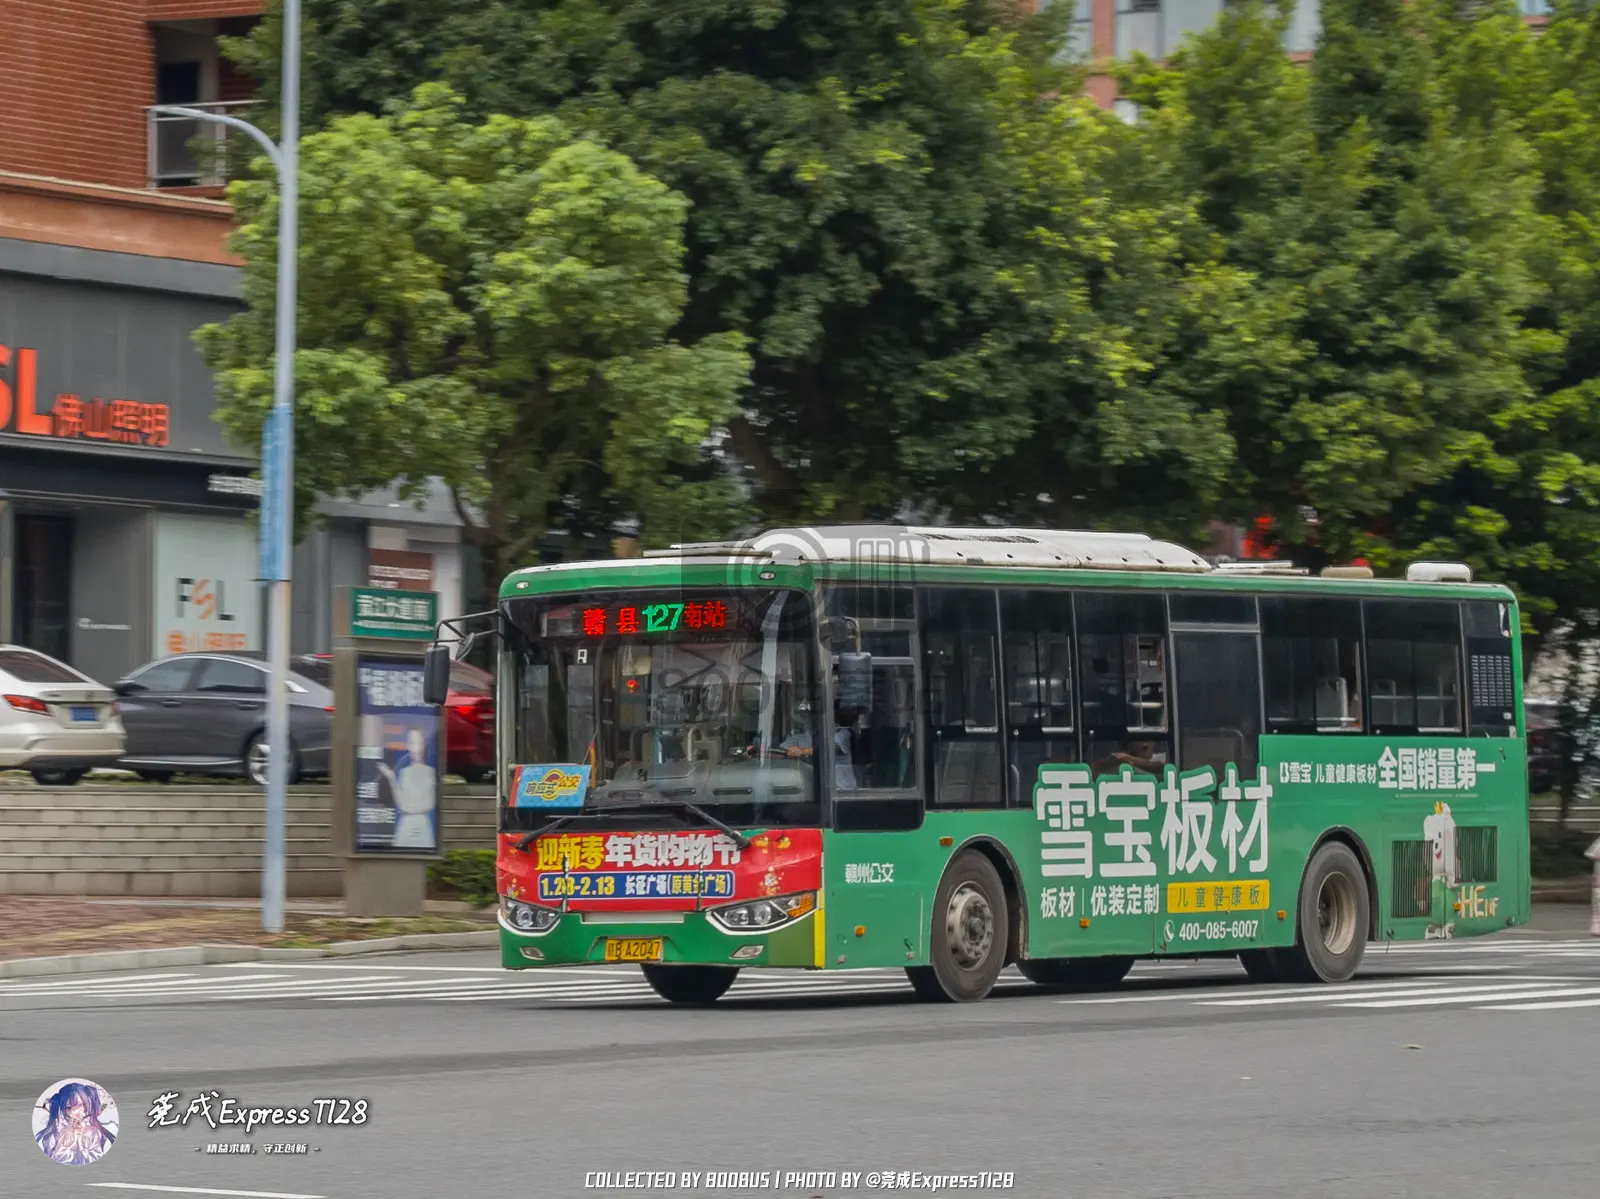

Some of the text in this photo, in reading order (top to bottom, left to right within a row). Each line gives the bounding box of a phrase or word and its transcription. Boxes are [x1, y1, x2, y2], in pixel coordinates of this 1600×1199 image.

[642, 603, 684, 631] 127
[684, 600, 726, 628] 南站
[1290, 746, 1496, 790] 雪宝 儿童健康板材 全国销量第一
[1036, 765, 1274, 879] 雪宝板材
[535, 834, 741, 871] 迎新春 年货购物节
[1041, 884, 1160, 918] 板材 优装定制
[1177, 884, 1260, 908] 儿童健康板
[1179, 920, 1259, 941] 400-085-6007
